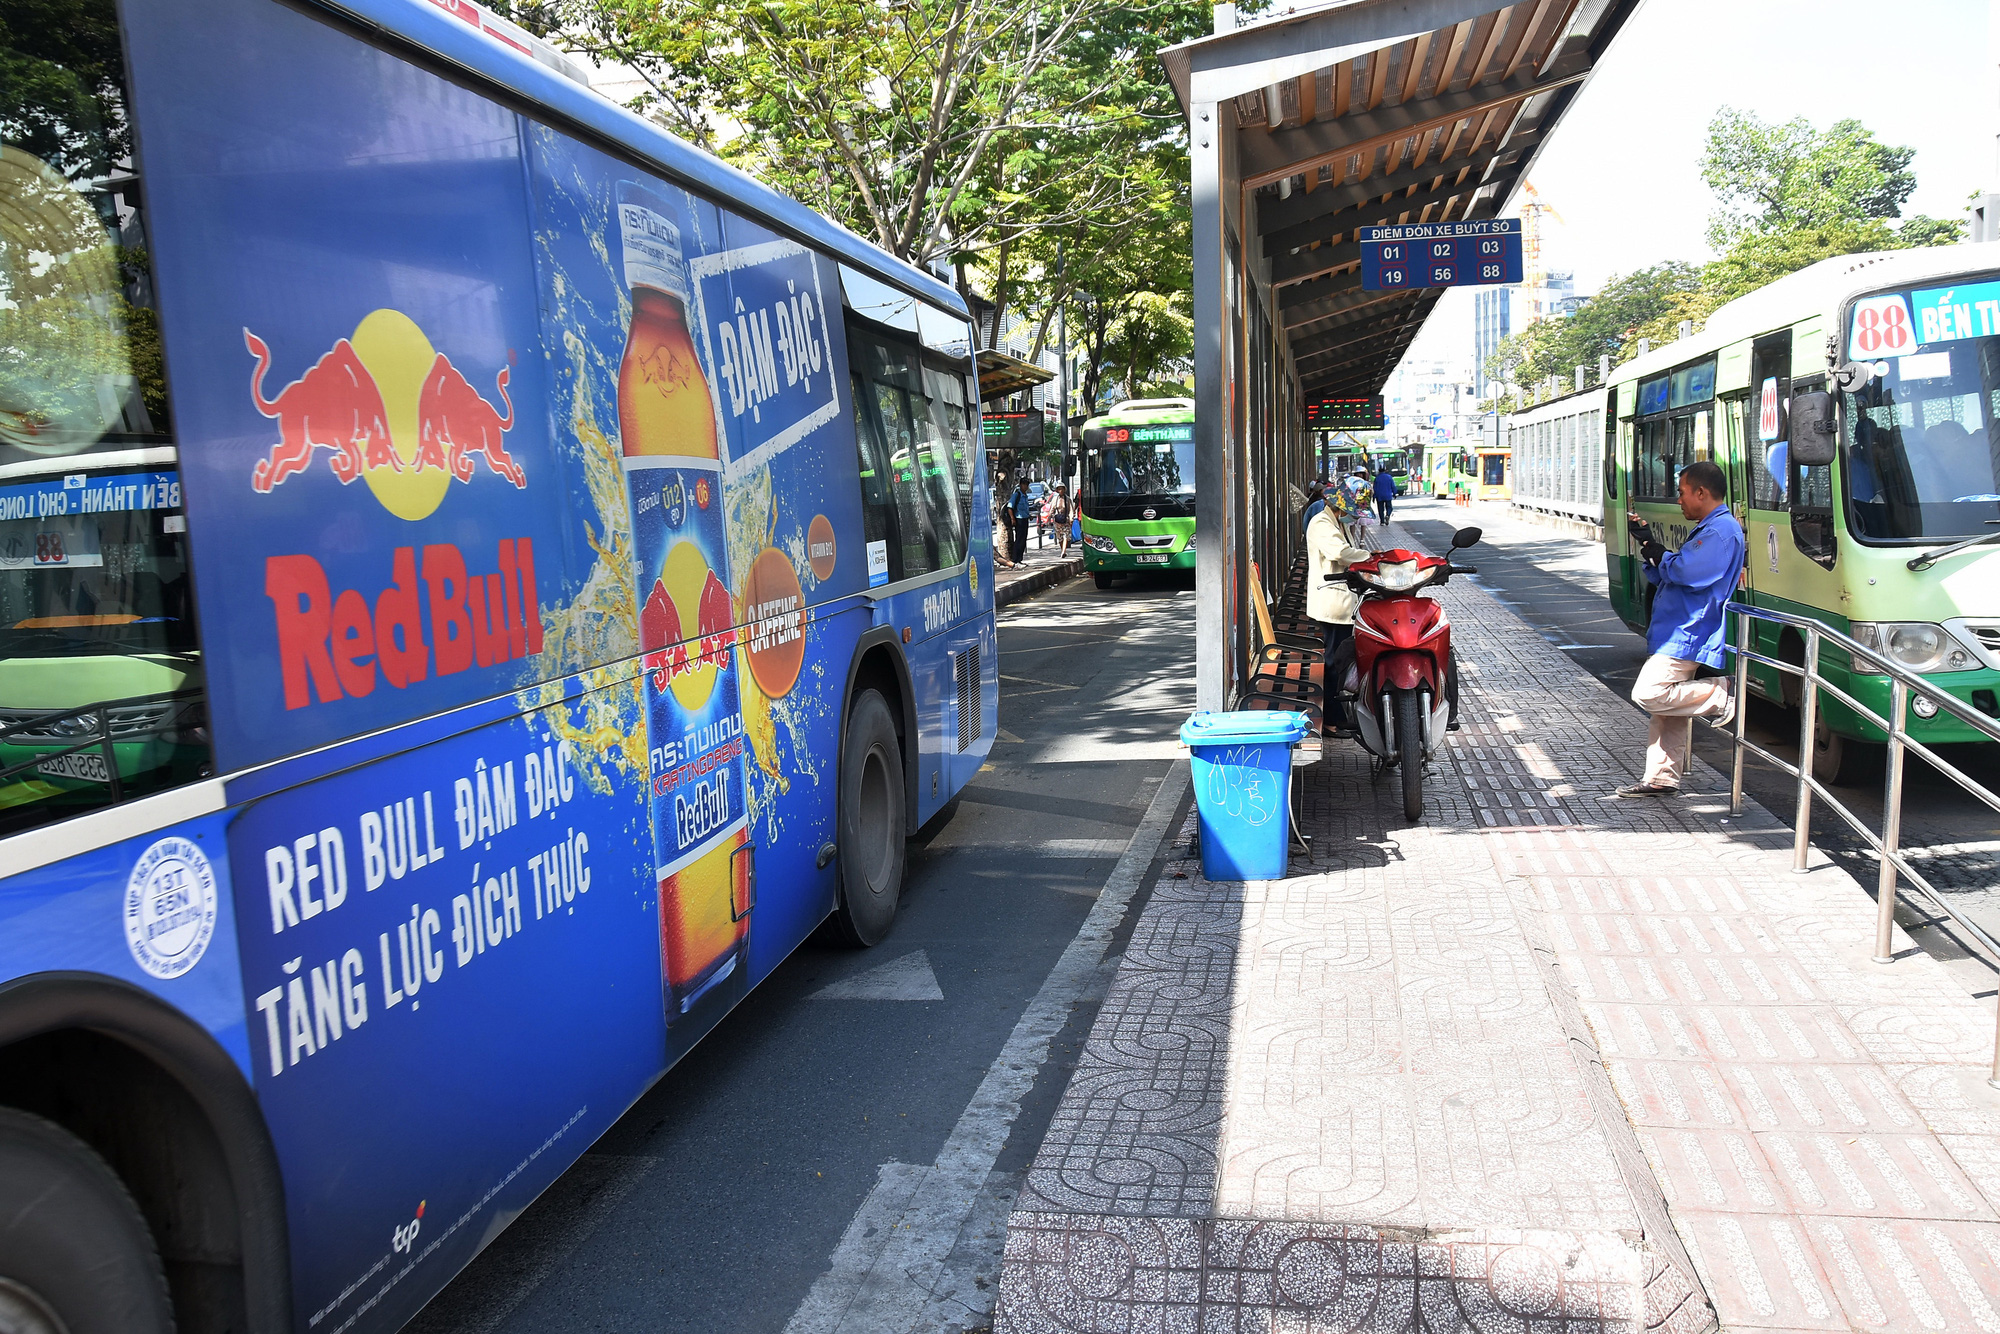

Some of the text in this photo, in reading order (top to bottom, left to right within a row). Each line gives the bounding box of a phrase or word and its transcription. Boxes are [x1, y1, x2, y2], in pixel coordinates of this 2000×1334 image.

[1384, 241, 1500, 260] 01 02 03
[1405, 225, 1432, 238] ĐÓN
[1436, 225, 1452, 236] XE
[1456, 221, 1489, 235] BUÝT
[1492, 221, 1510, 232] SỐ
[1385, 265, 1500, 283] 19 56 88
[1857, 305, 1907, 351] 88
[1921, 290, 1973, 342] BẾN
[719, 280, 822, 424] ĐẬM ĐẶC
[1107, 429, 1129, 442] 39
[1762, 387, 1775, 432] 88
[747, 594, 802, 654] CAFFEINE
[653, 738, 743, 798] KRATINGDAENG
[265, 732, 574, 935] RED BULL ĐẬM ĐẶC
[256, 826, 592, 1078] TĂNG LỰC ĐÍCH THỰC
[391, 1217, 421, 1254] tcp
